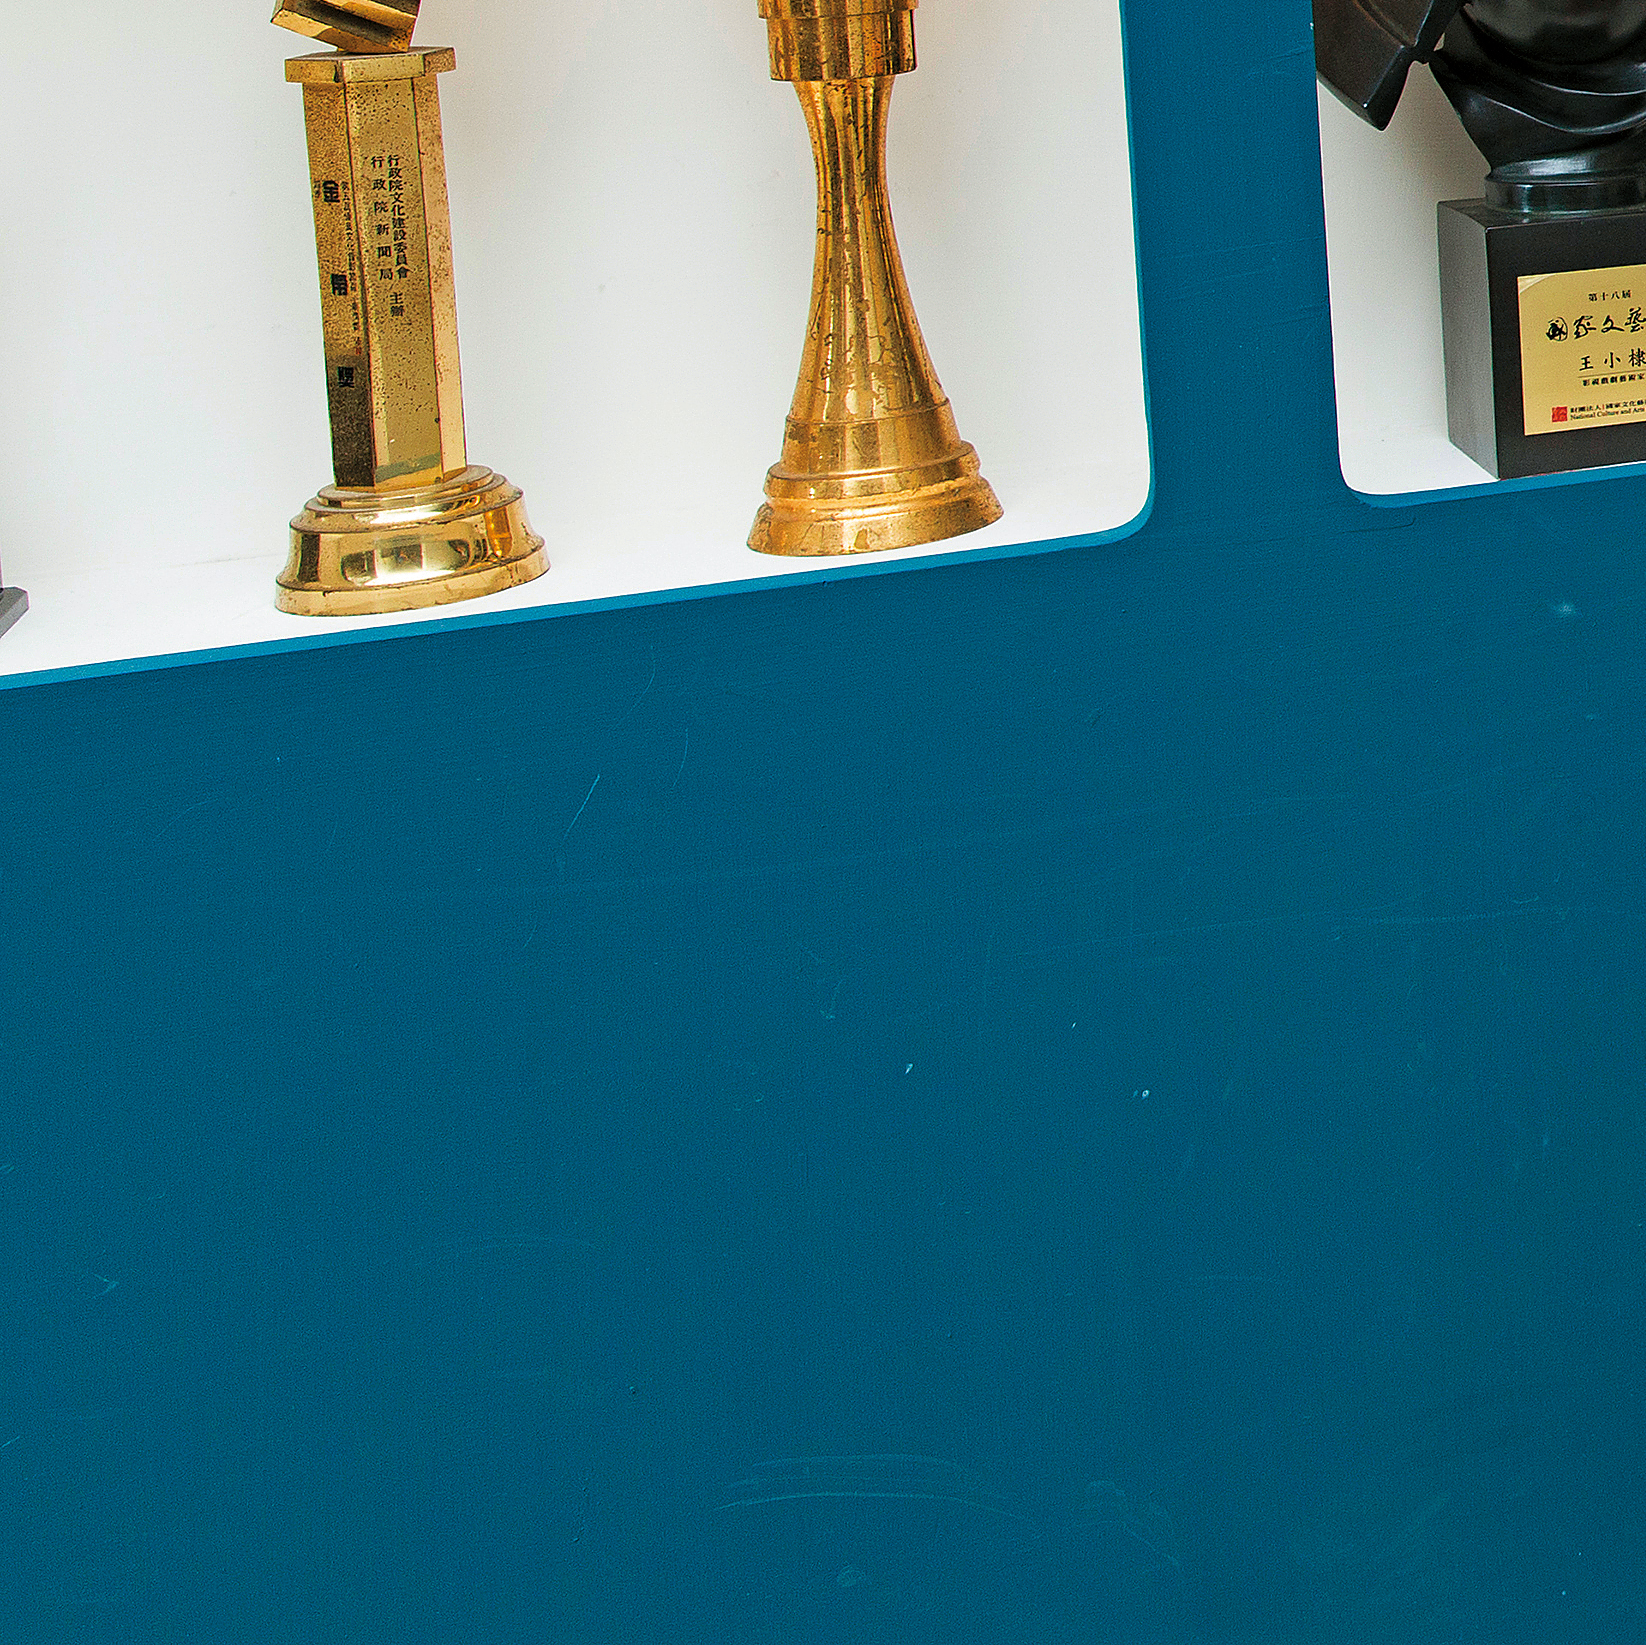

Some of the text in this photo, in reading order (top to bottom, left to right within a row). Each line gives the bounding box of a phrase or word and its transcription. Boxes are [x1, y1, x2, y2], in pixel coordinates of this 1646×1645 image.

[371, 156, 394, 281] 行政院新聞局
[387, 154, 411, 279] 行政院文化建設委員會
